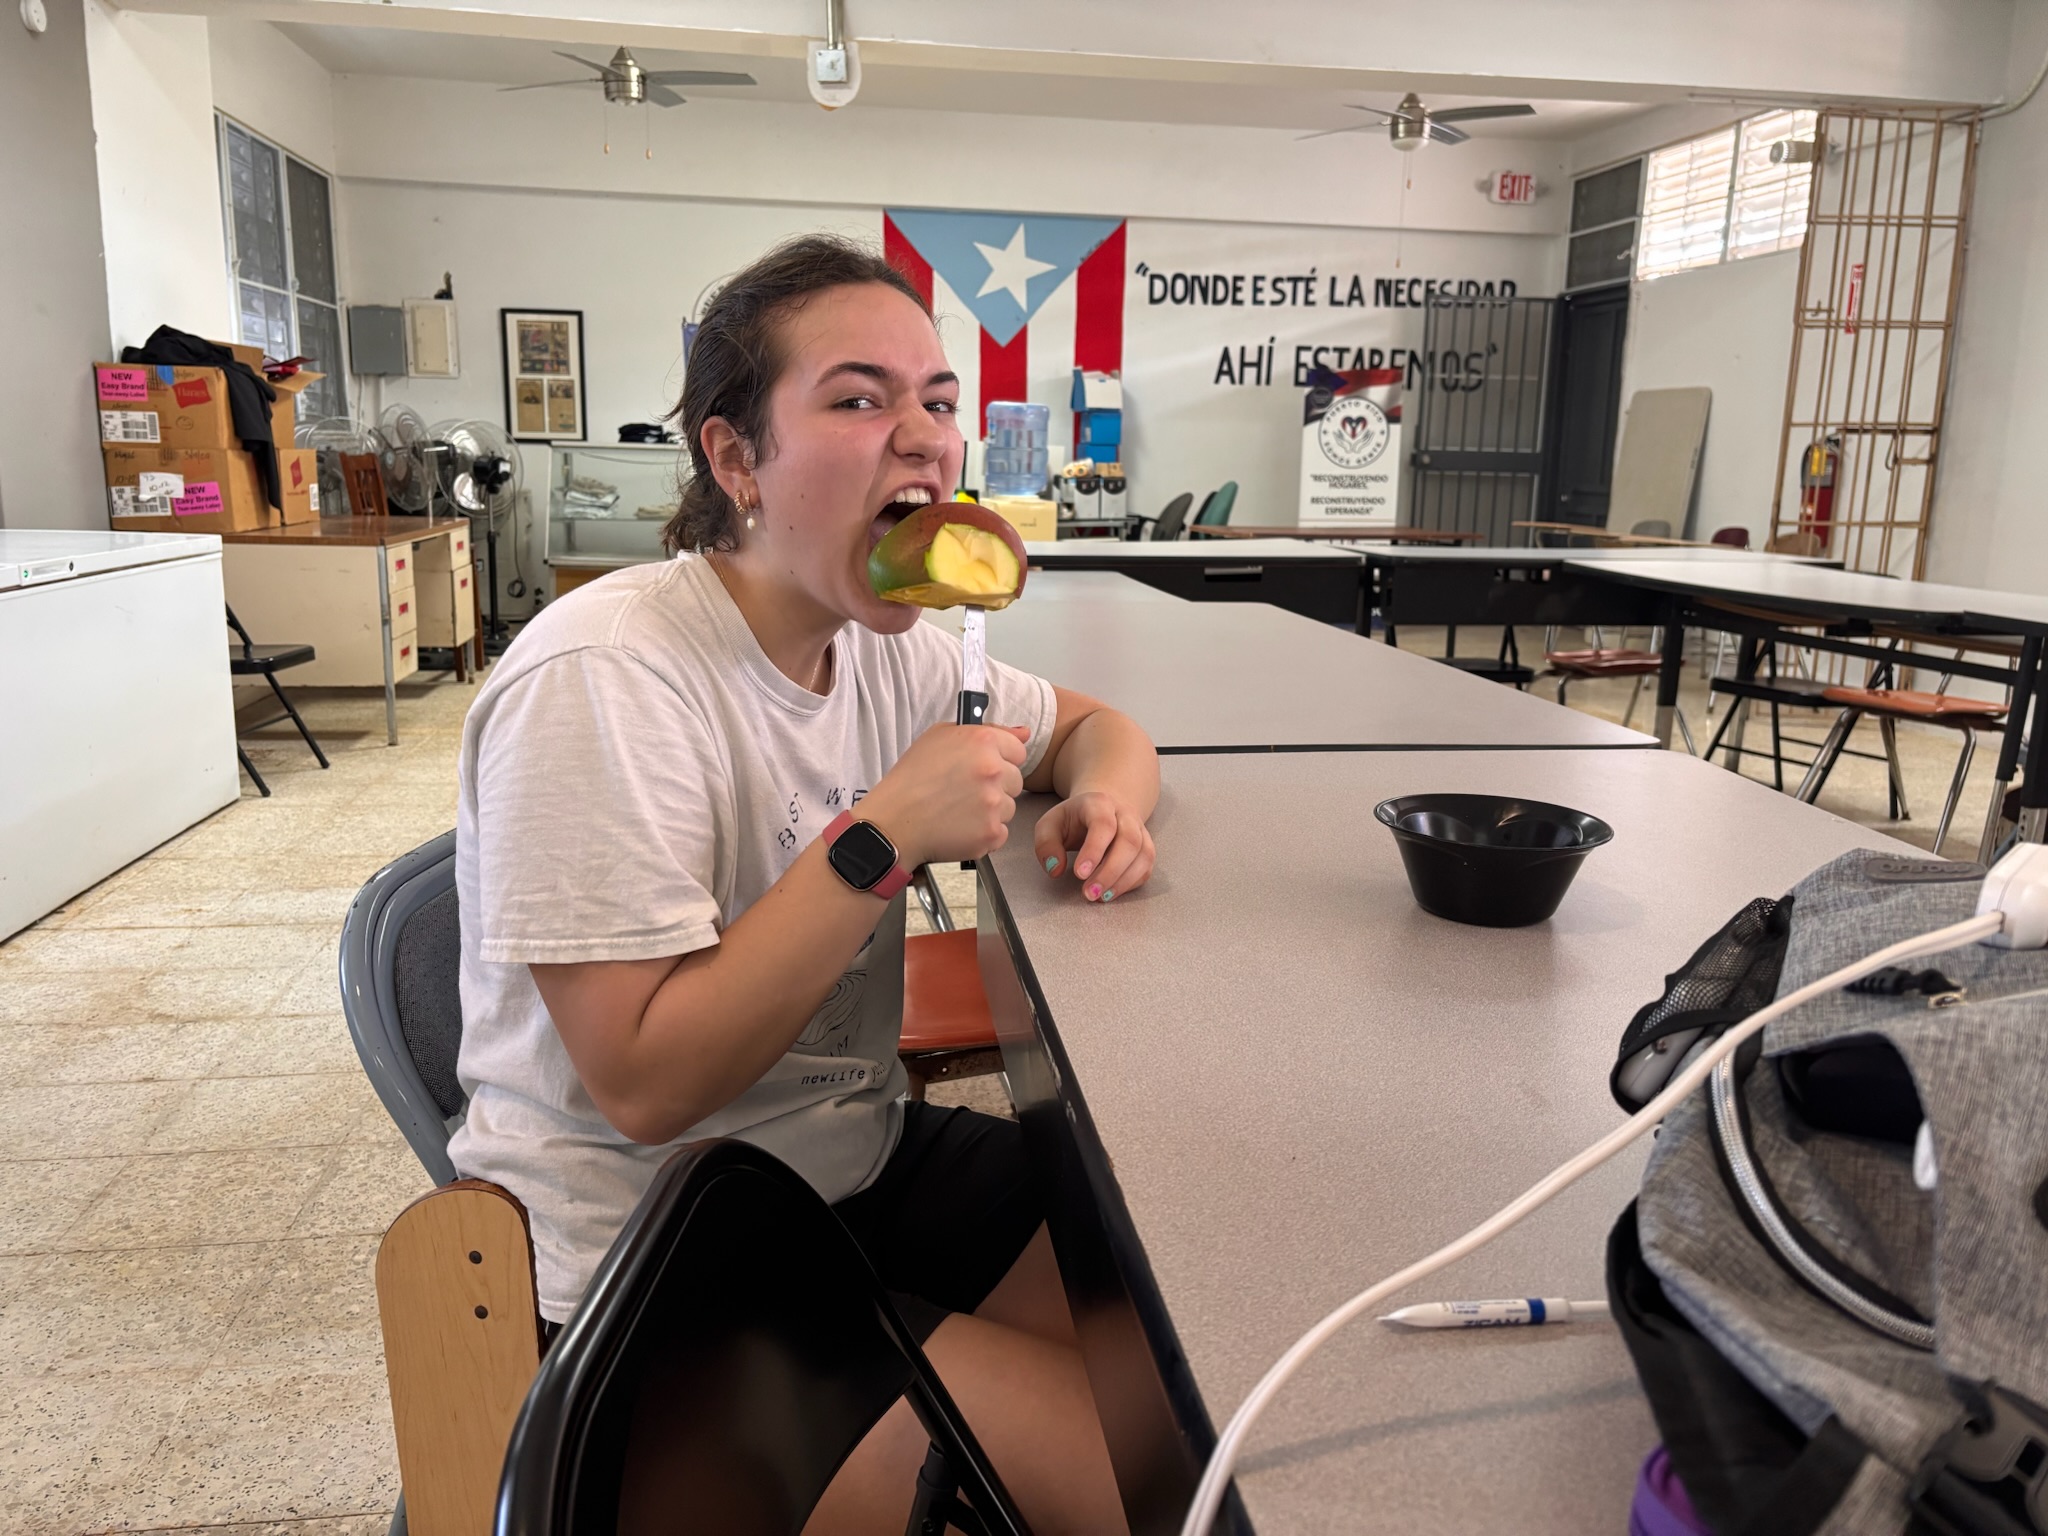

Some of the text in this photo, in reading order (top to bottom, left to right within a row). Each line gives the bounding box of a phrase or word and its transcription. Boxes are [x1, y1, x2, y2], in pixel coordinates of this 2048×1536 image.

[1499, 174, 1531, 201] EXIT
[1252, 267, 1317, 306] ESTÉ
[1329, 275, 1364, 307] LA
[1374, 278, 1517, 308] NECESIDAD
[1214, 336, 1276, 386] AHÍ
[101, 382, 145, 390] Easy Brand
[184, 486, 205, 495] NEW
[196, 495, 219, 503] Brand
[1311, 496, 1386, 505] RECONSTRUYENDO
